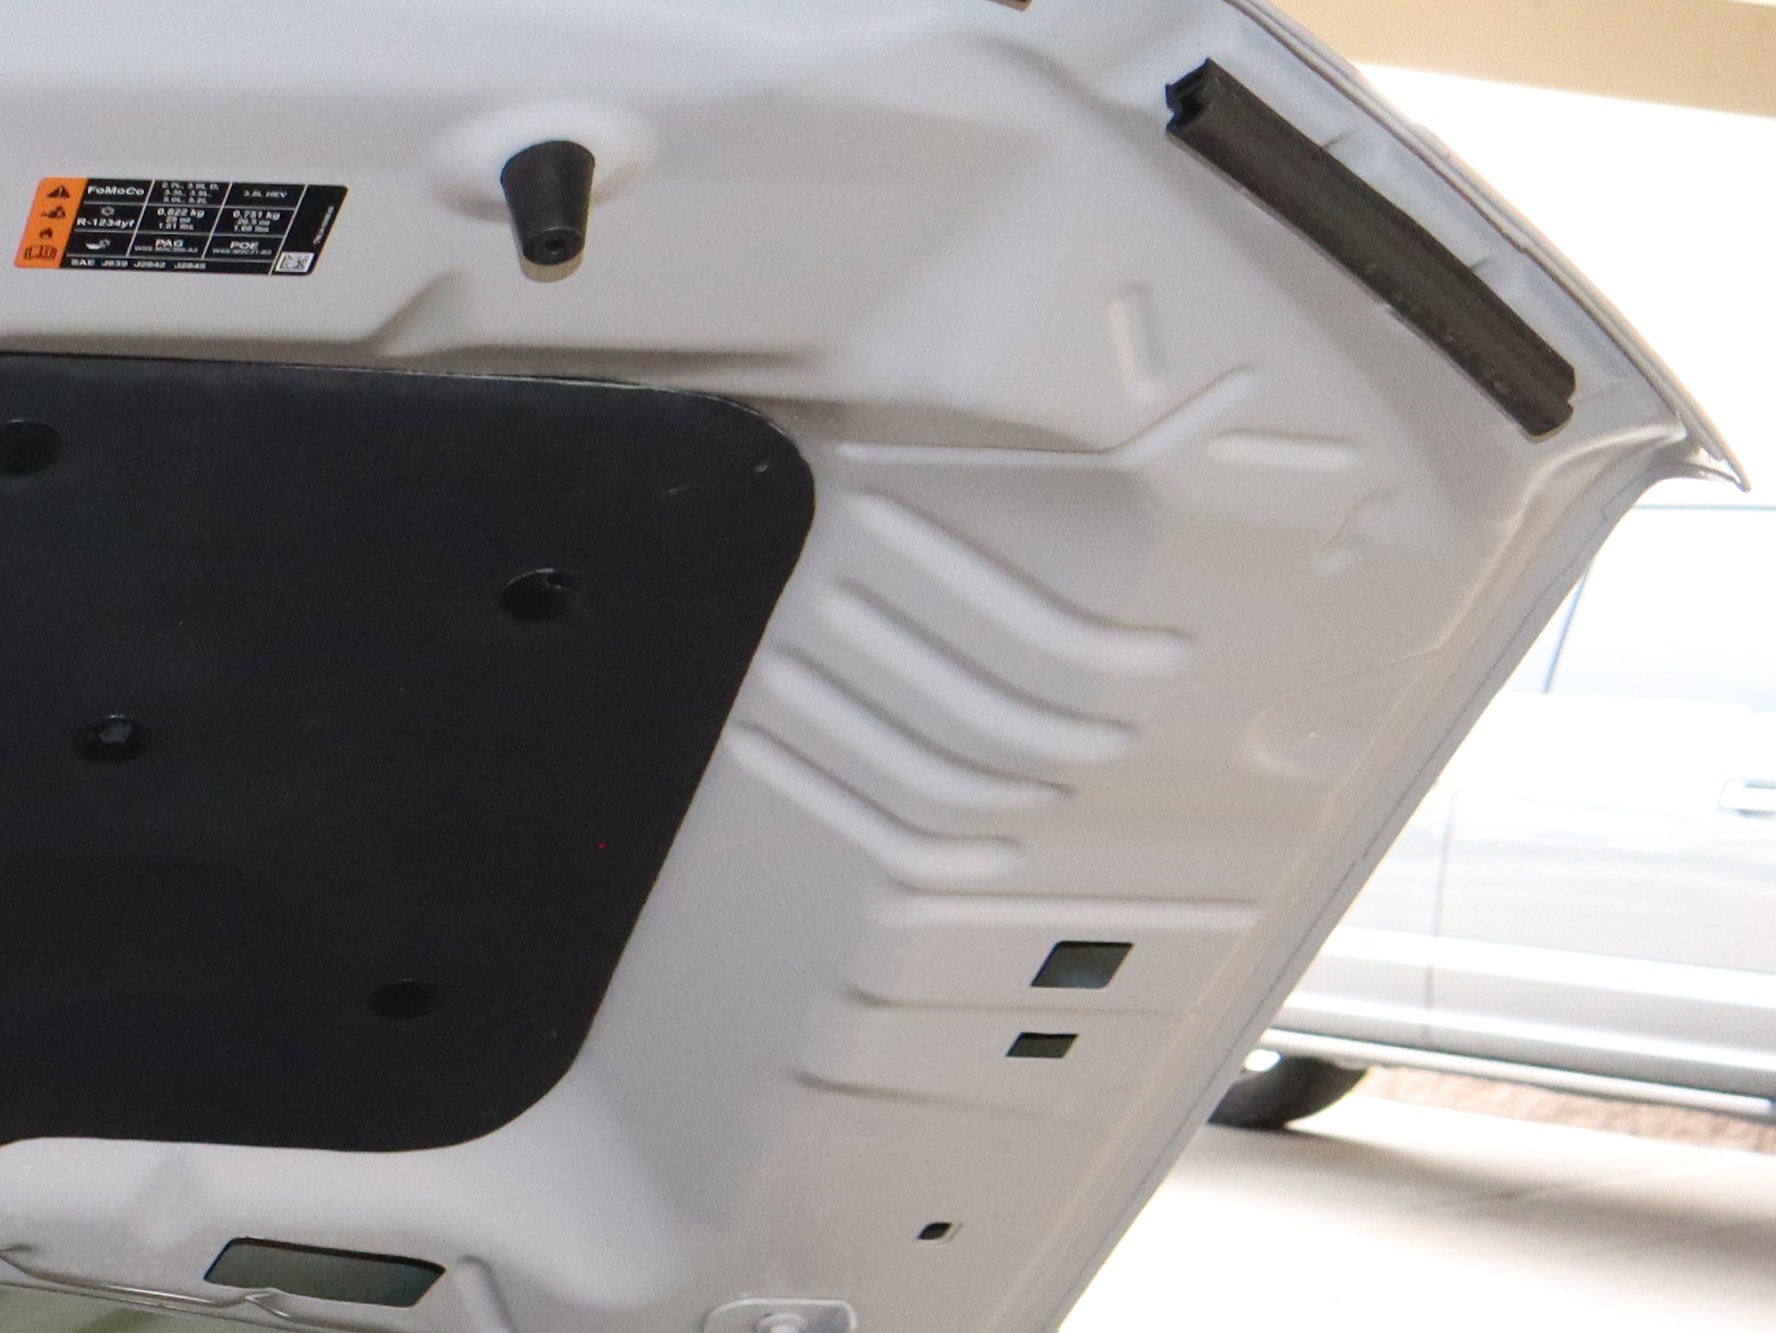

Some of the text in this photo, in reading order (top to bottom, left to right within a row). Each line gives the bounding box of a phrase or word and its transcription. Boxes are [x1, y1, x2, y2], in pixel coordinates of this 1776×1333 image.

[87, 185, 145, 196] FoMoCo
[77, 217, 136, 229] R-1234yf
[155, 239, 184, 249] PAG
[70, 258, 95, 267] SAE
